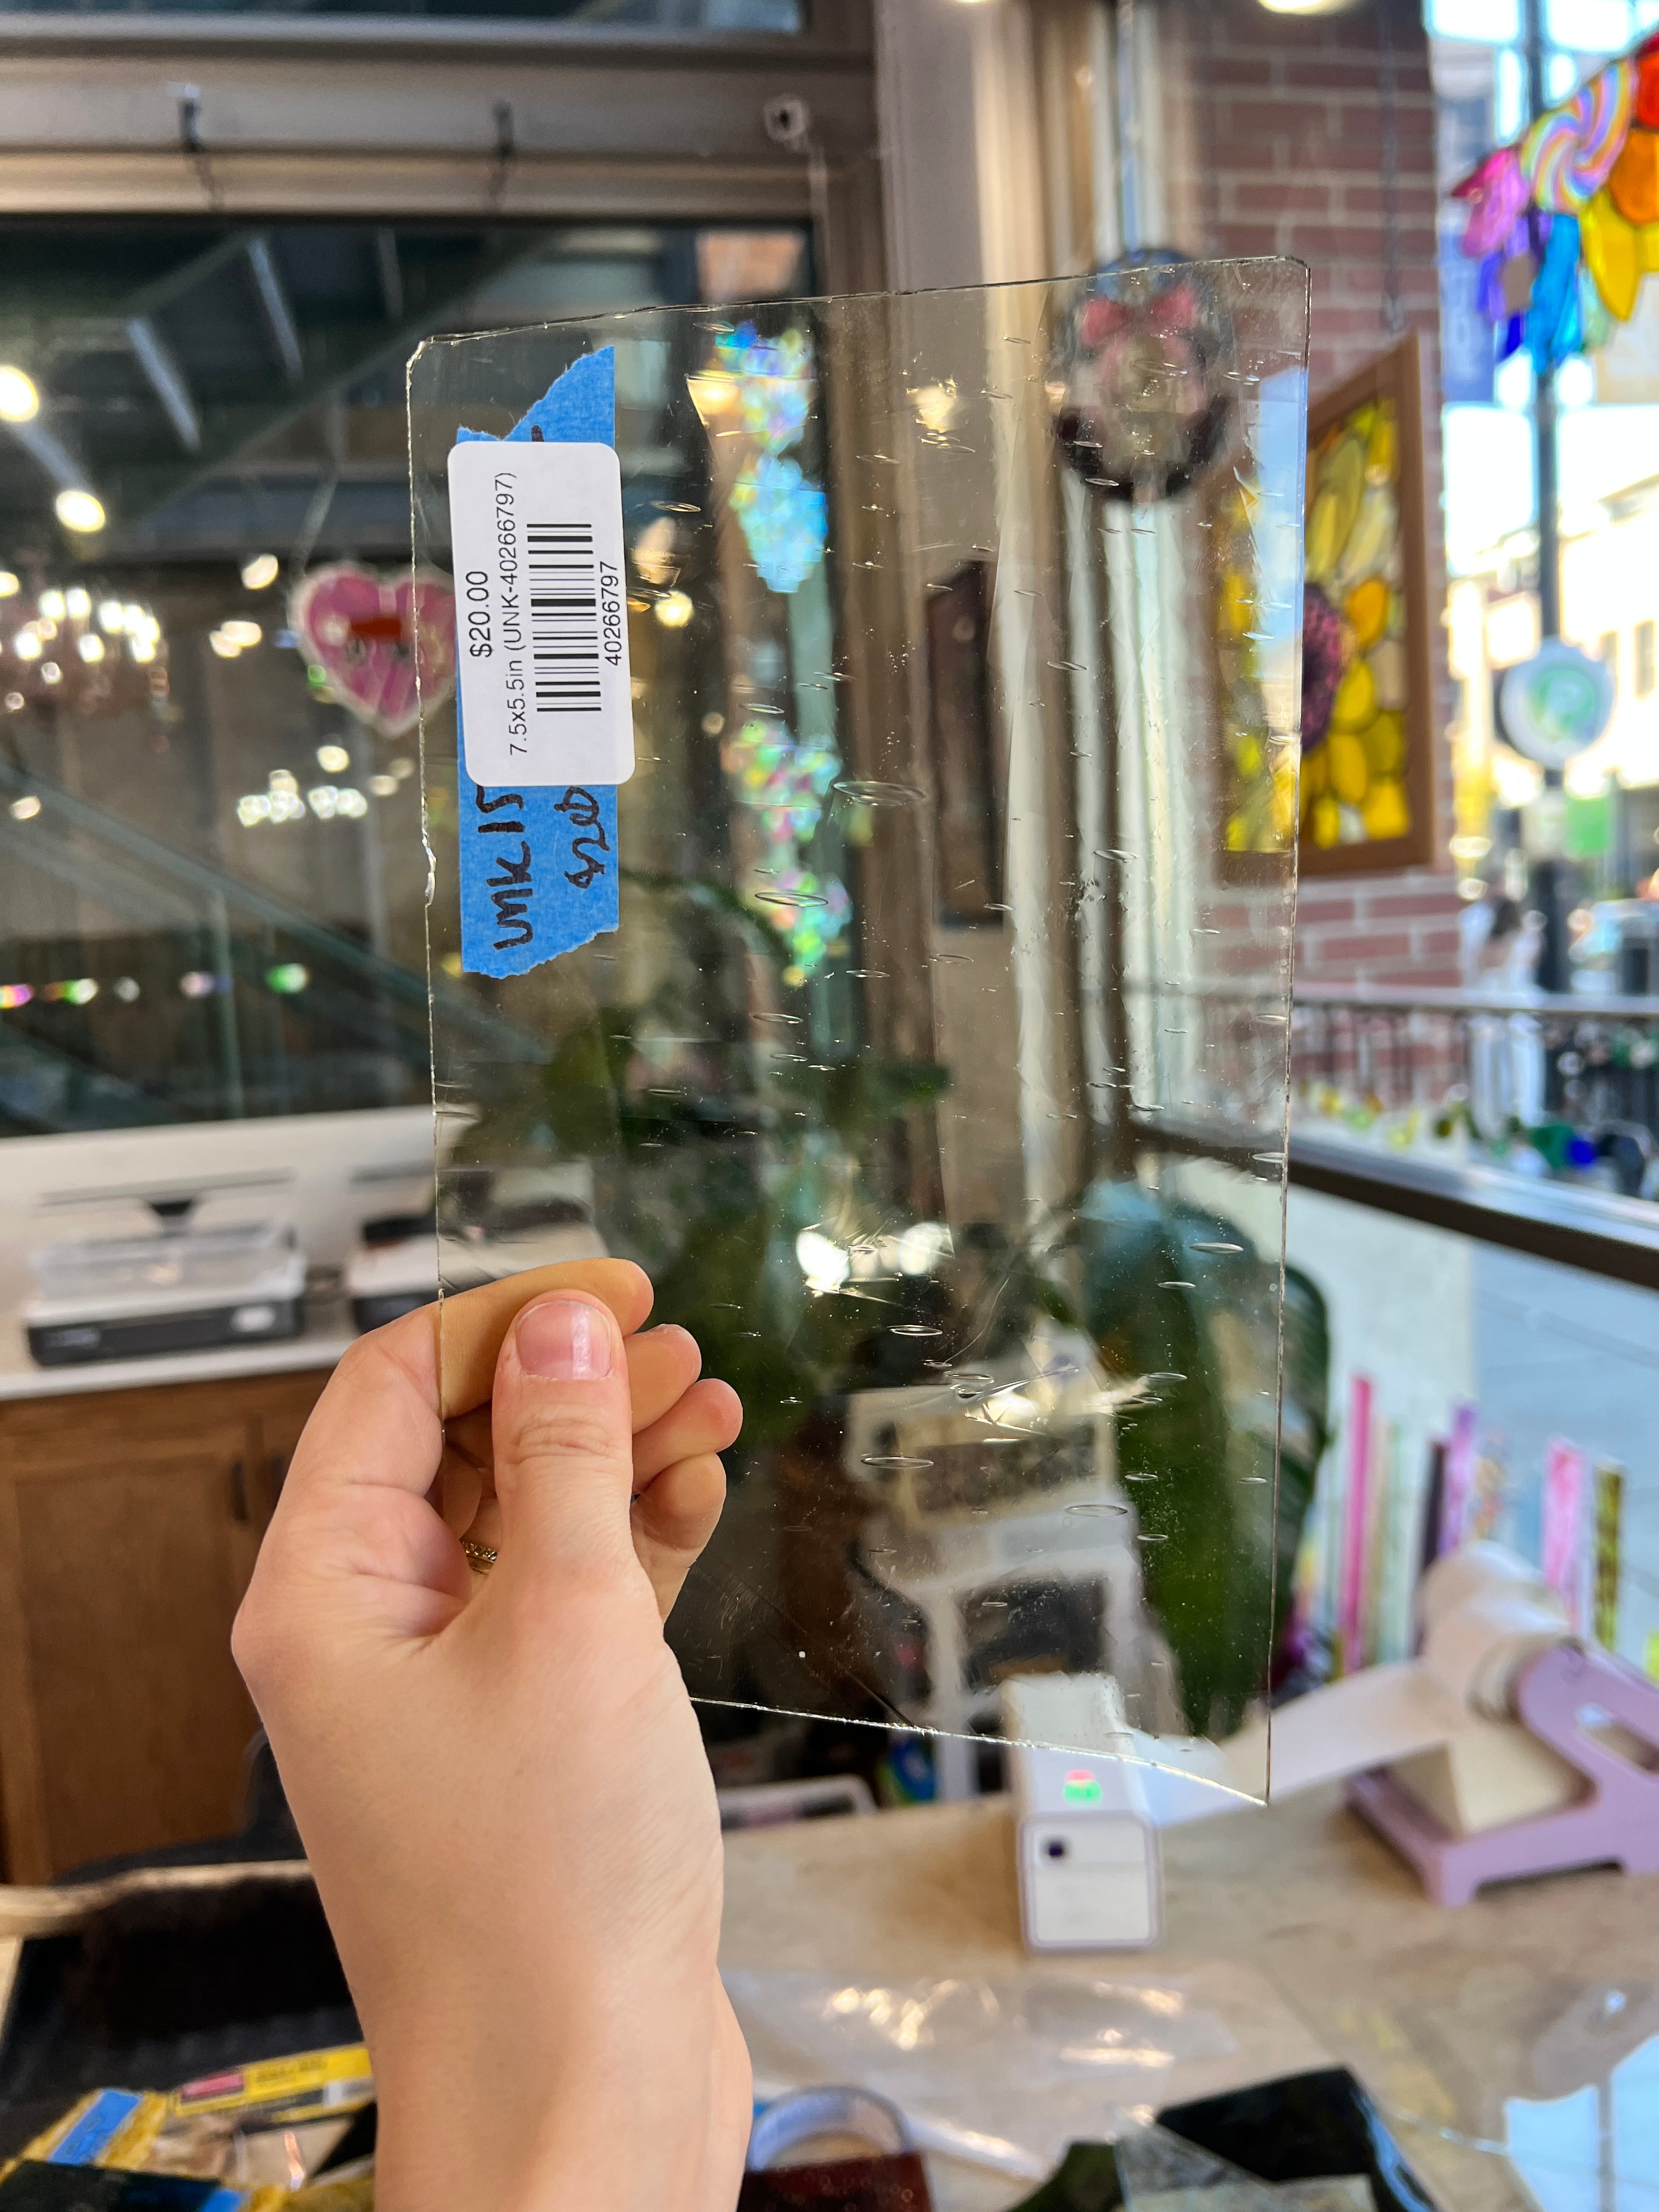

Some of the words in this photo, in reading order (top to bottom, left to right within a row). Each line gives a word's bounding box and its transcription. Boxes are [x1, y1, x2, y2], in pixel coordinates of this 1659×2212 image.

[495, 472, 526, 652] (UNK-40266797)
[465, 571, 493, 658] $20.00
[600, 561, 622, 666] 40266797
[505, 660, 527, 756] 7.5x5.5in
